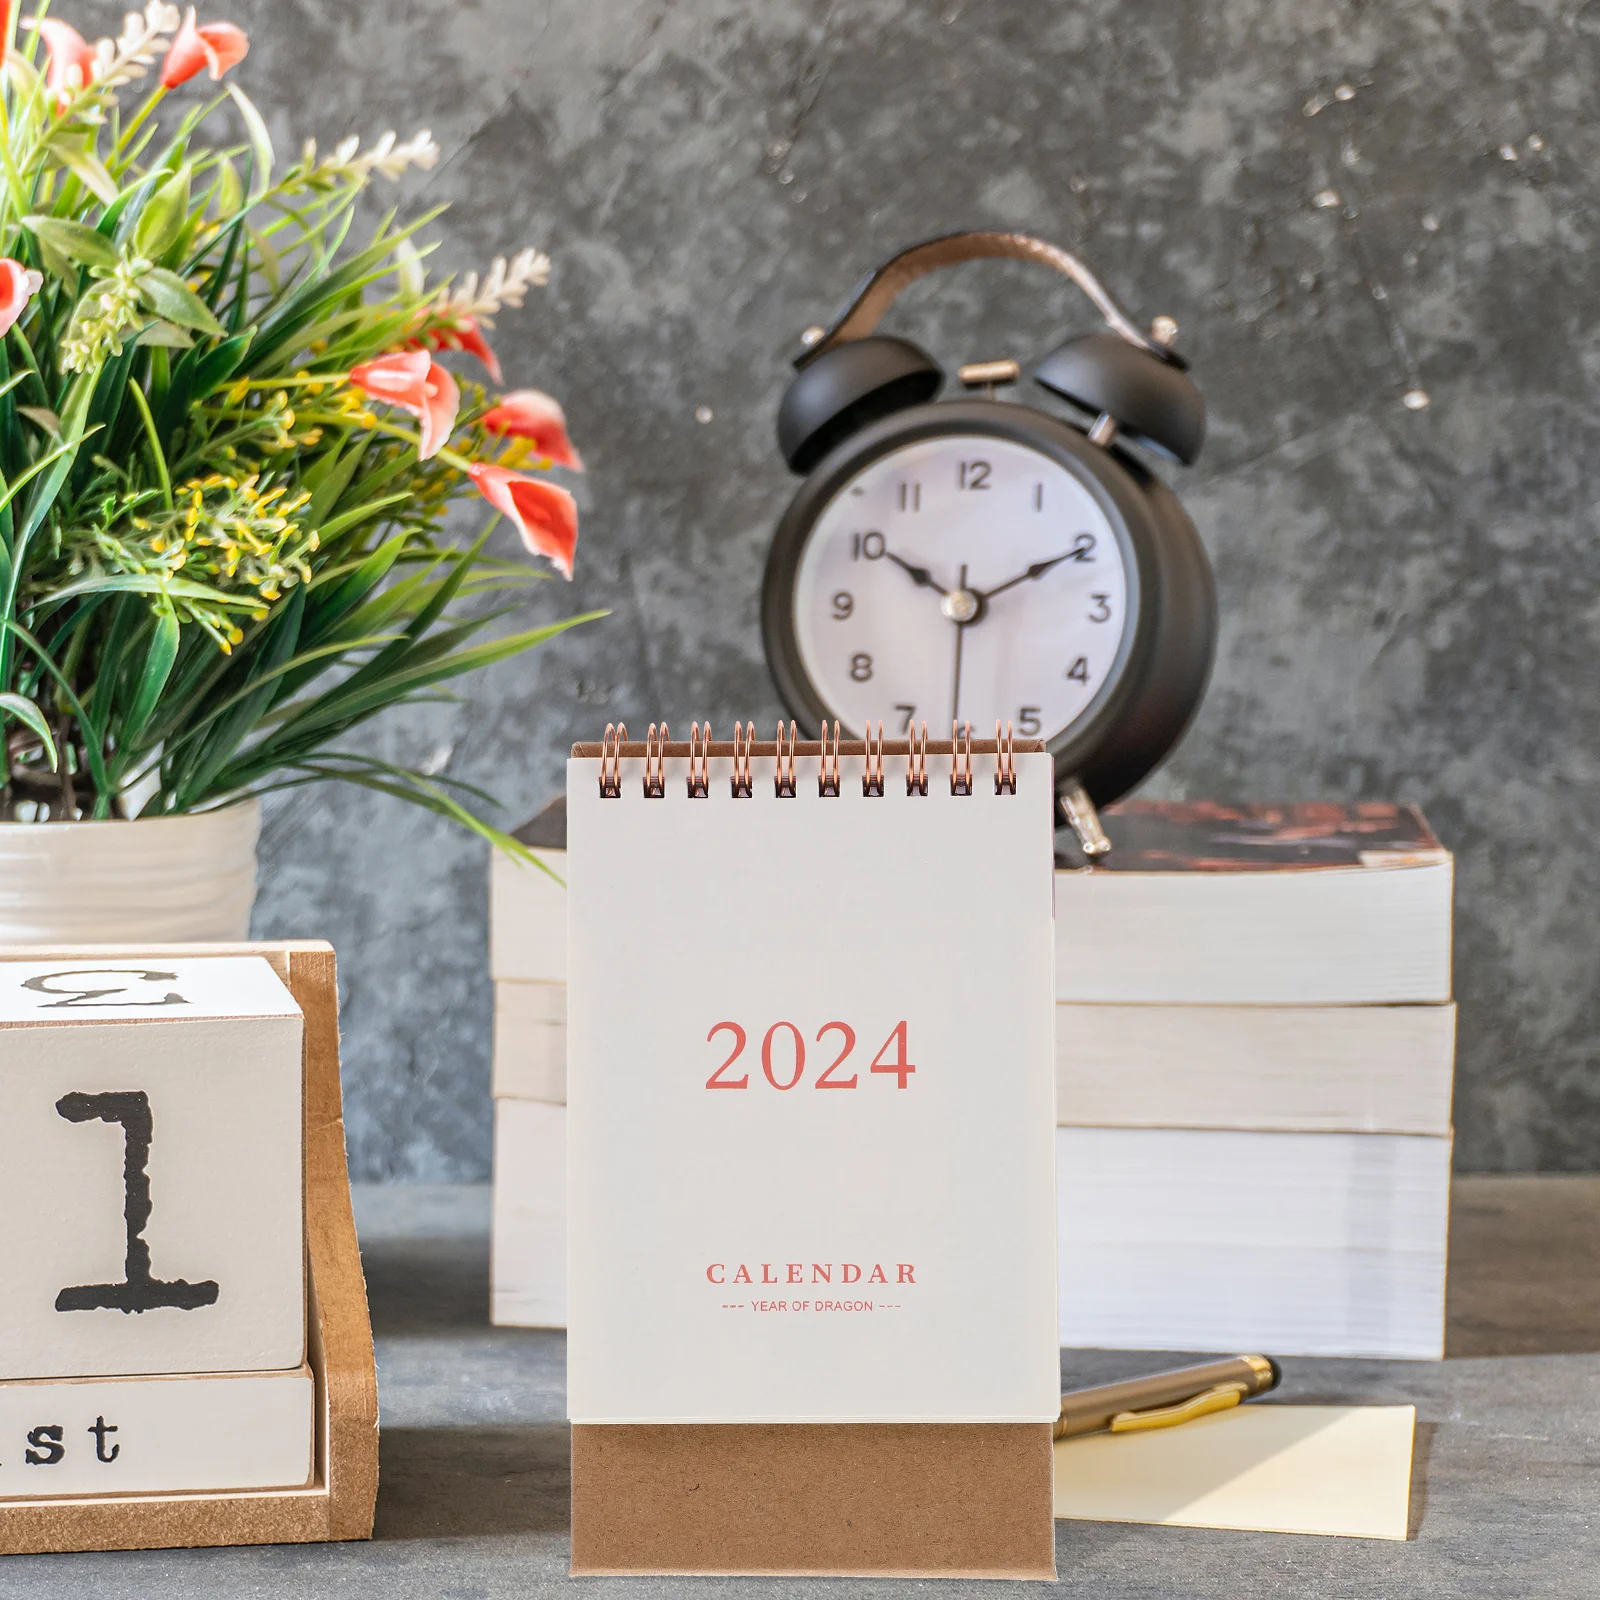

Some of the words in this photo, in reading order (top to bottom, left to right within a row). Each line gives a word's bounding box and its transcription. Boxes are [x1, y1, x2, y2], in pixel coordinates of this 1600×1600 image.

[959, 461, 991, 490] 12
[900, 483, 920, 512] 11
[1035, 483, 1043, 512] 1
[852, 532, 886, 561] 10
[1074, 532, 1096, 562] 2
[832, 592, 854, 620] 9
[1088, 594, 1111, 624] 3
[850, 653, 874, 682] 8
[1066, 657, 1091, 685] 4
[895, 704, 916, 736] 7
[1018, 707, 1042, 736] 5
[705, 1021, 916, 1090] 2024
[56, 1090, 219, 1314] 1
[706, 1263, 917, 1284] CALENDAR
[751, 1301, 787, 1312] YEAR
[792, 1301, 810, 1312] OF
[815, 1301, 873, 1312] DRAGON
[0, 1415, 120, 1466] st
